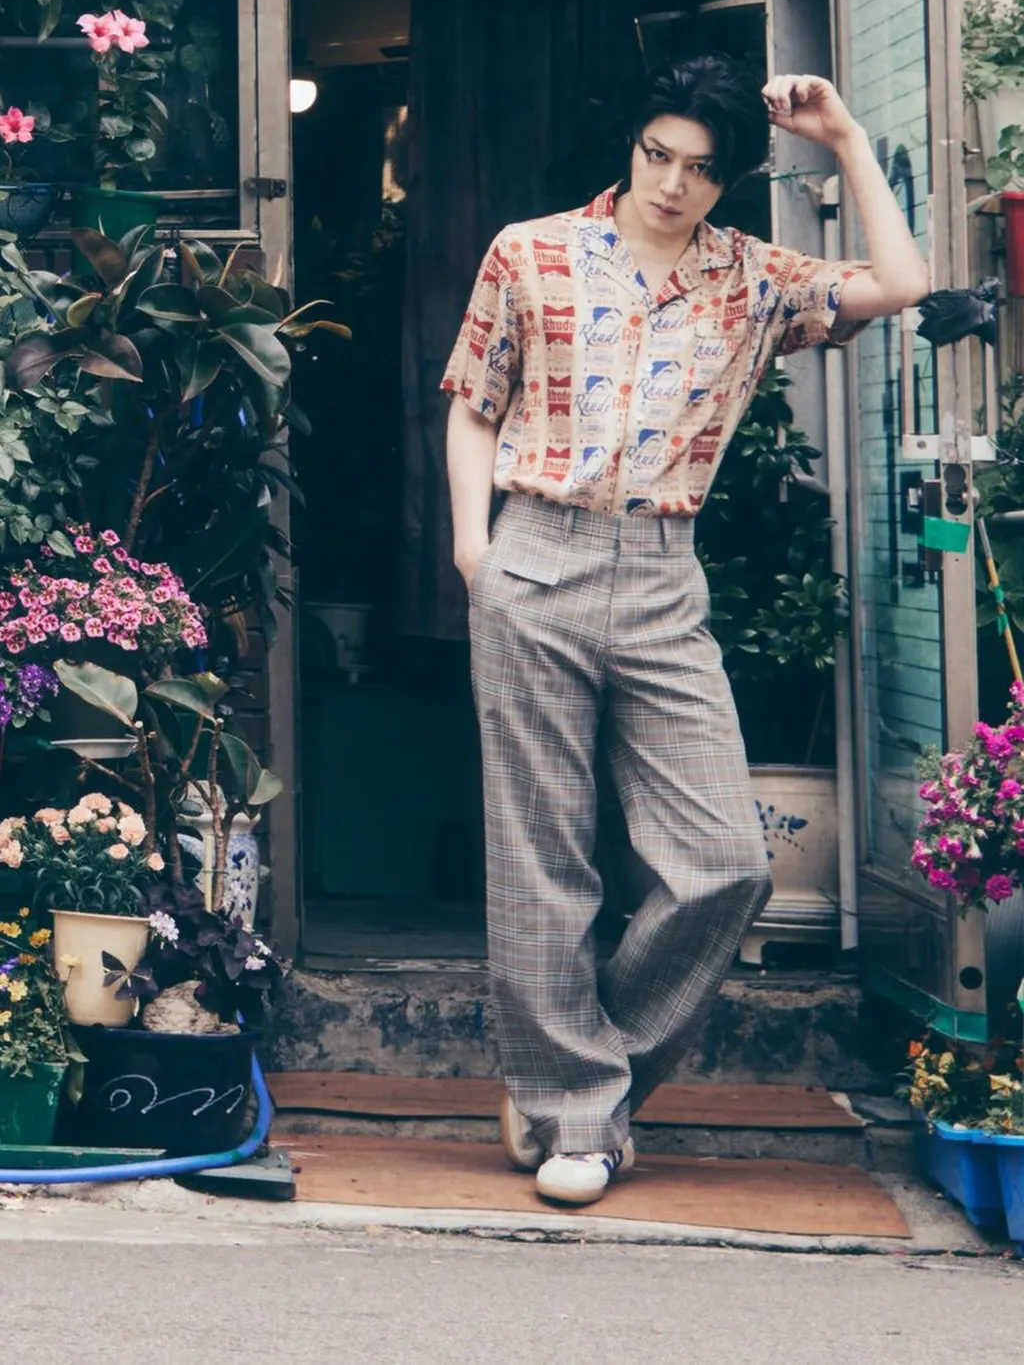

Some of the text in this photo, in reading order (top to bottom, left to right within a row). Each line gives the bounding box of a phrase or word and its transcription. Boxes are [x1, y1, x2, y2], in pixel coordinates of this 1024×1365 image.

[542, 318, 576, 332] Rhude
[578, 322, 620, 349] Rhude
[637, 377, 680, 400] Rhude
[575, 392, 610, 417] Rhude
